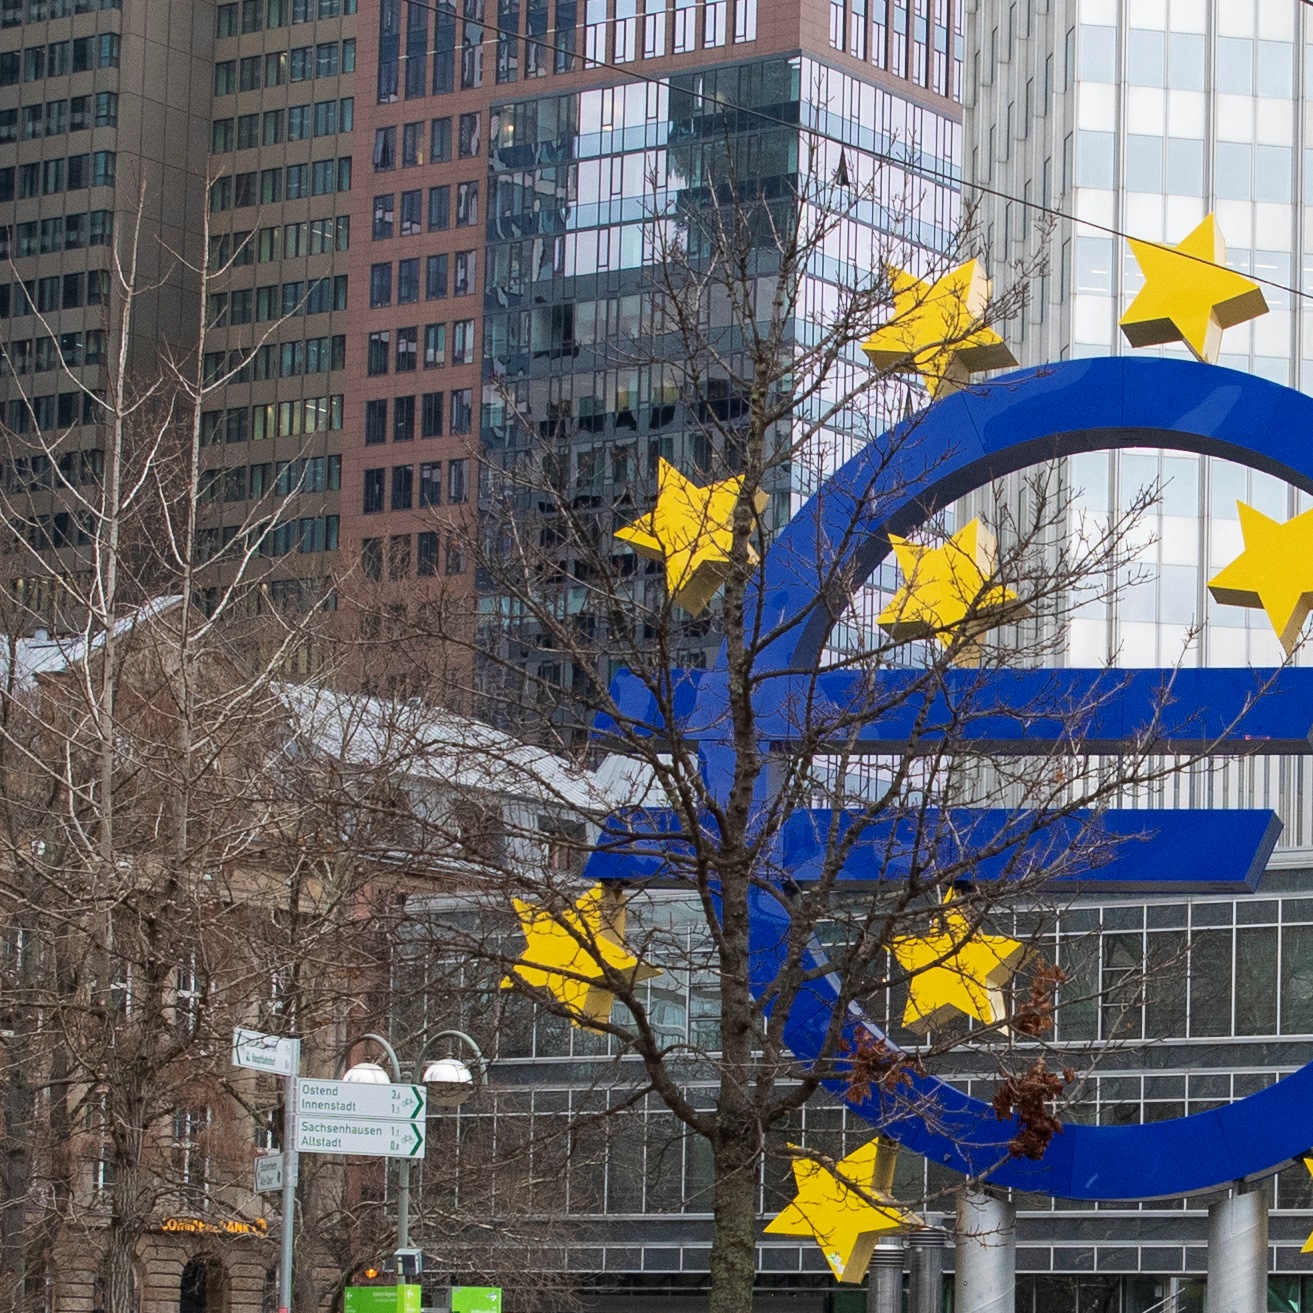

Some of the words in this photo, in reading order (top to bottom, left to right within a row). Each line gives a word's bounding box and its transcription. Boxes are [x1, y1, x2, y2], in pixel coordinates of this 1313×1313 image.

[302, 1084, 339, 1096] Ostend
[301, 1098, 356, 1112] Innenstadt
[301, 1121, 383, 1136] Sachsenhausen
[301, 1136, 342, 1149] Altstadt
